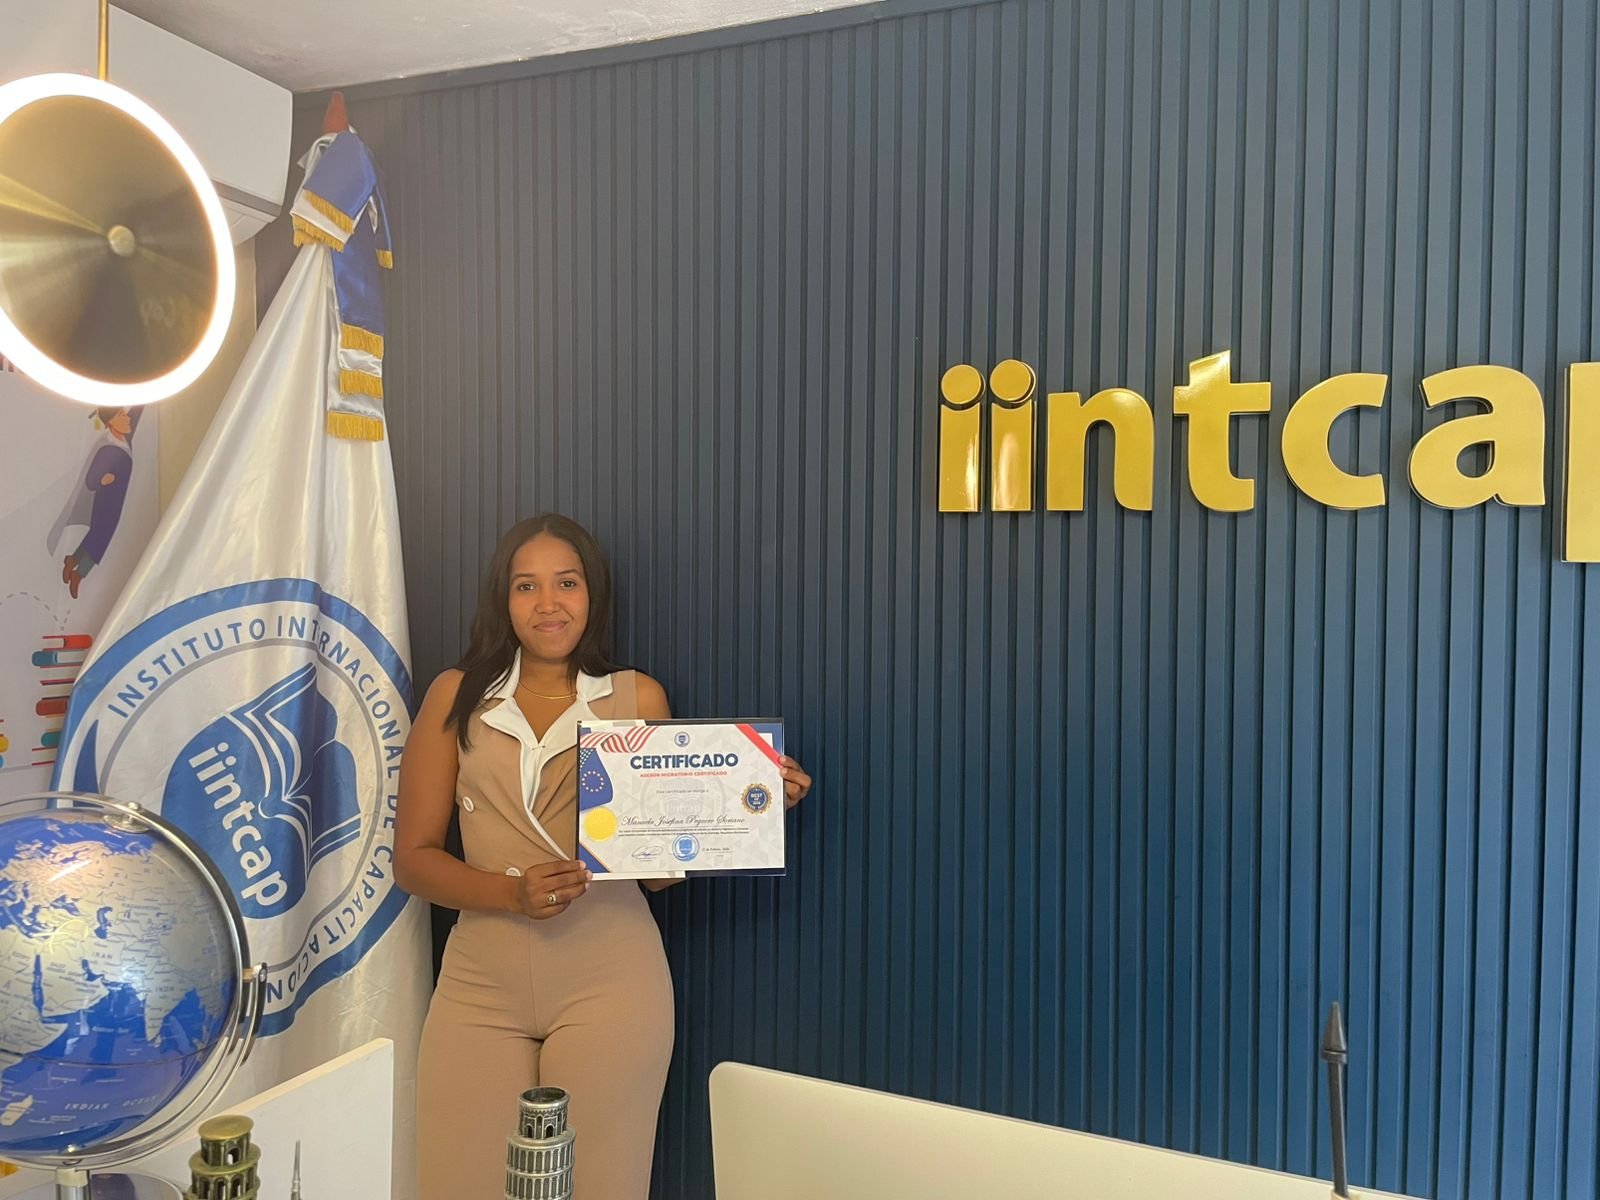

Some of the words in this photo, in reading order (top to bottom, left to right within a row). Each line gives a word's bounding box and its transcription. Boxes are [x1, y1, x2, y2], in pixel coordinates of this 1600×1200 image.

[938, 351, 1600, 563] iintca
[107, 618, 266, 719] INSTITUTO
[277, 615, 404, 779] INTRNACIONAL
[630, 753, 739, 770] CERTIFICADO
[188, 742, 288, 906] iintcap
